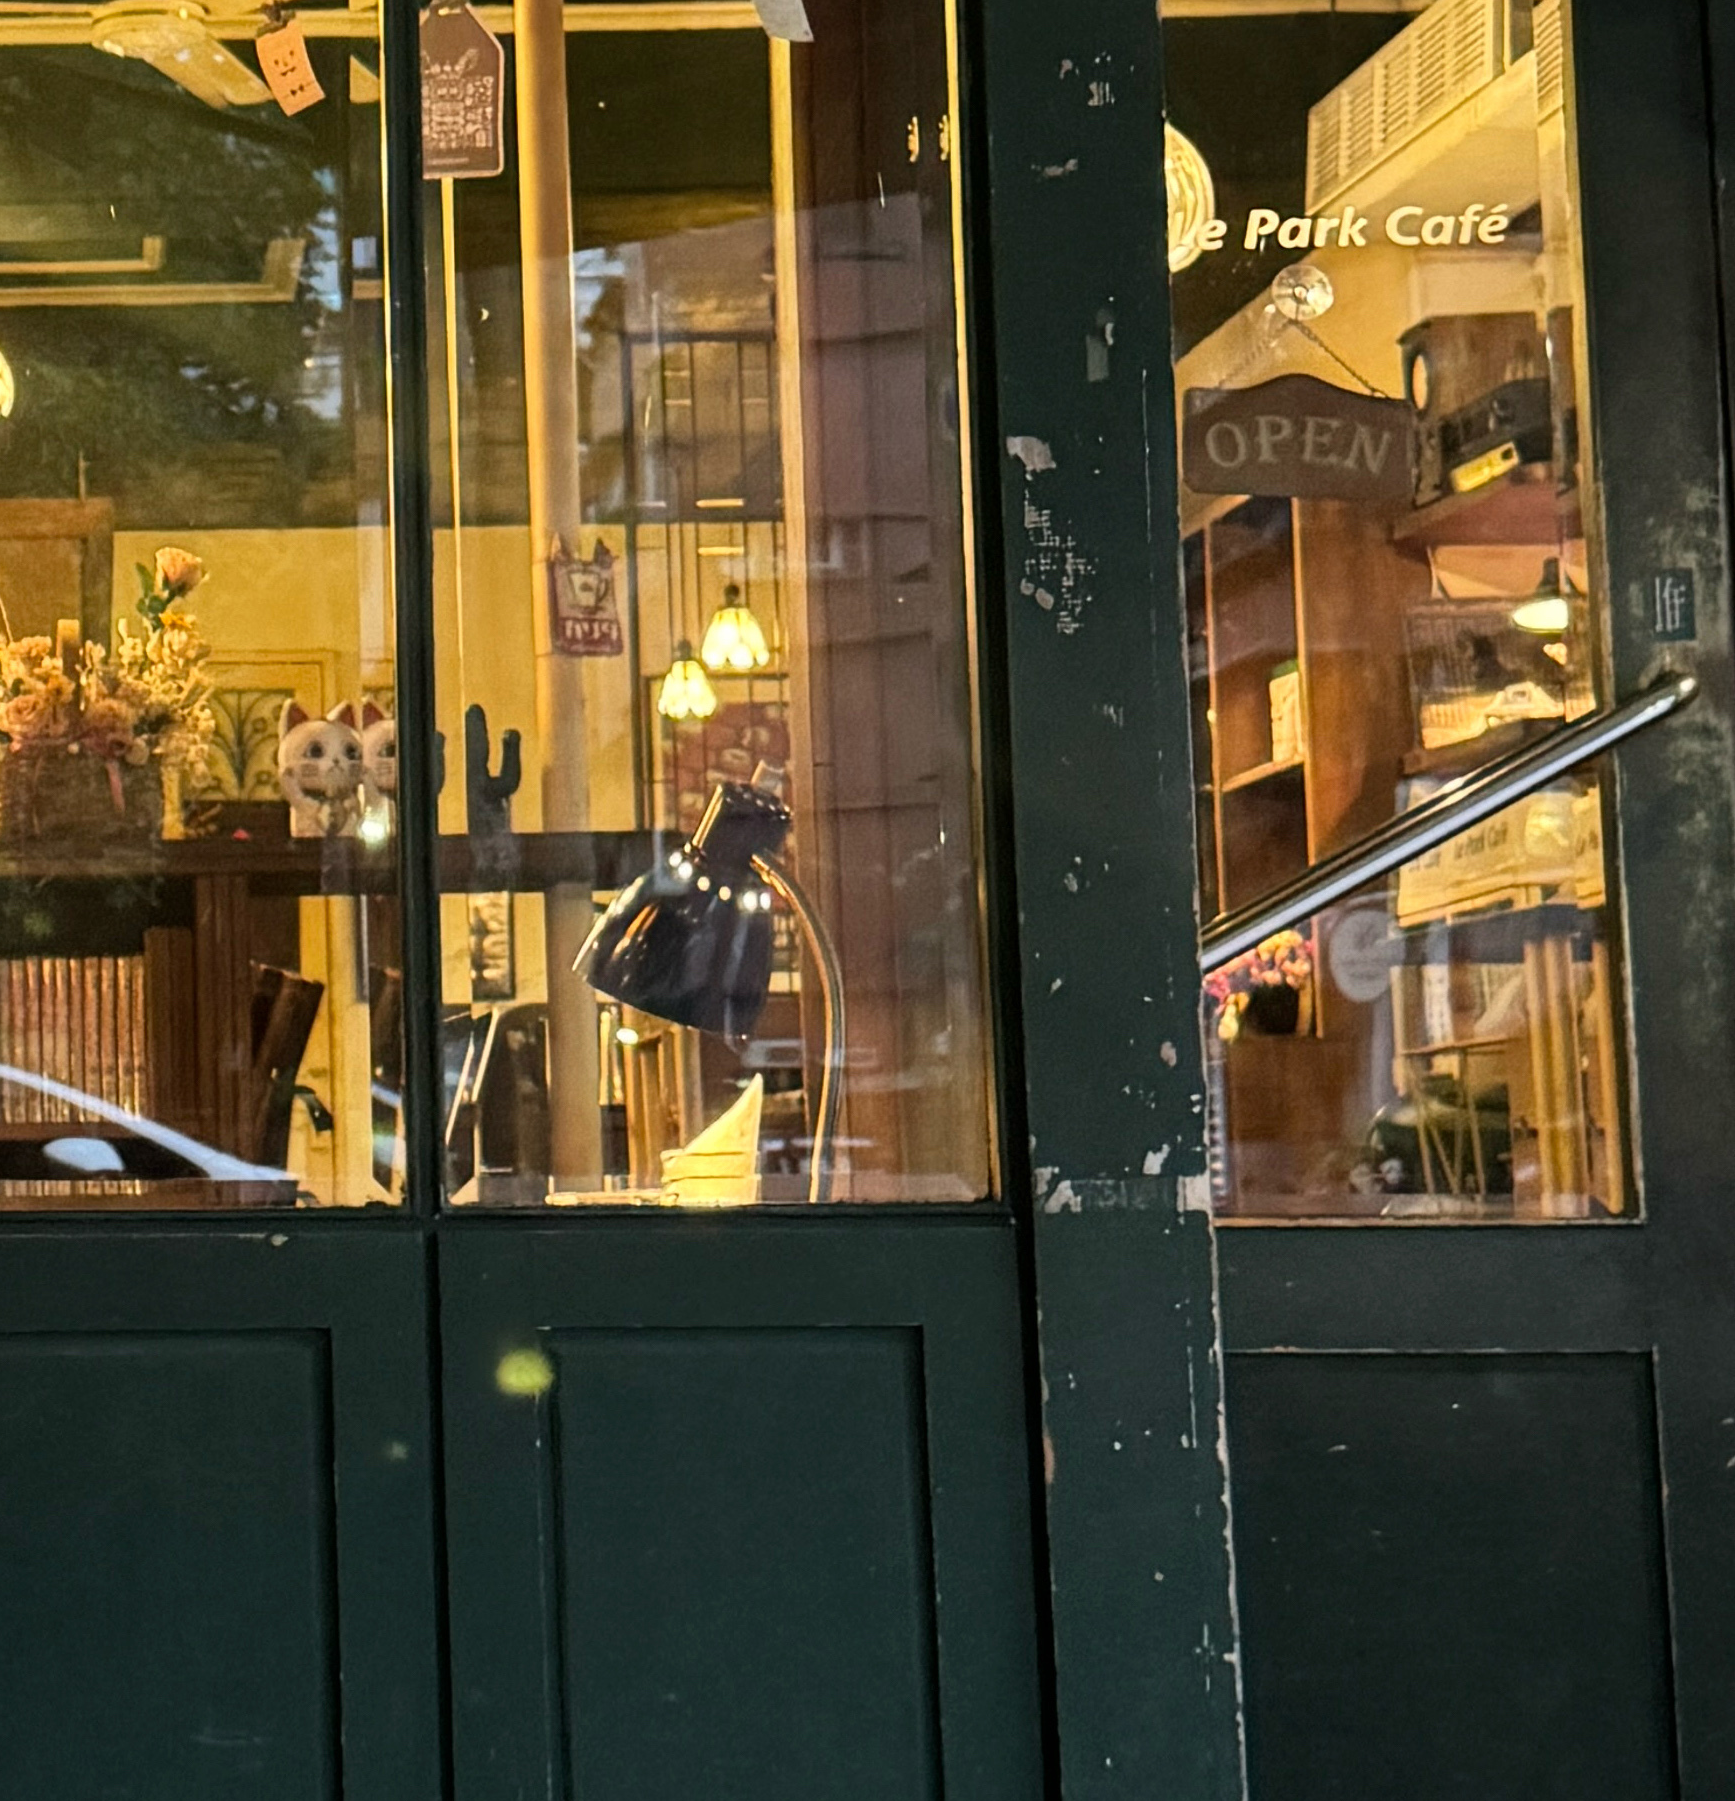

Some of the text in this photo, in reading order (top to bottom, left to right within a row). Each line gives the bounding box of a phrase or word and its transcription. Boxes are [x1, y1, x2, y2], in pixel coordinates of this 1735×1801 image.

[1244, 206, 1368, 250] Park
[1385, 203, 1508, 247] Café
[1205, 415, 1391, 475] OPEN
